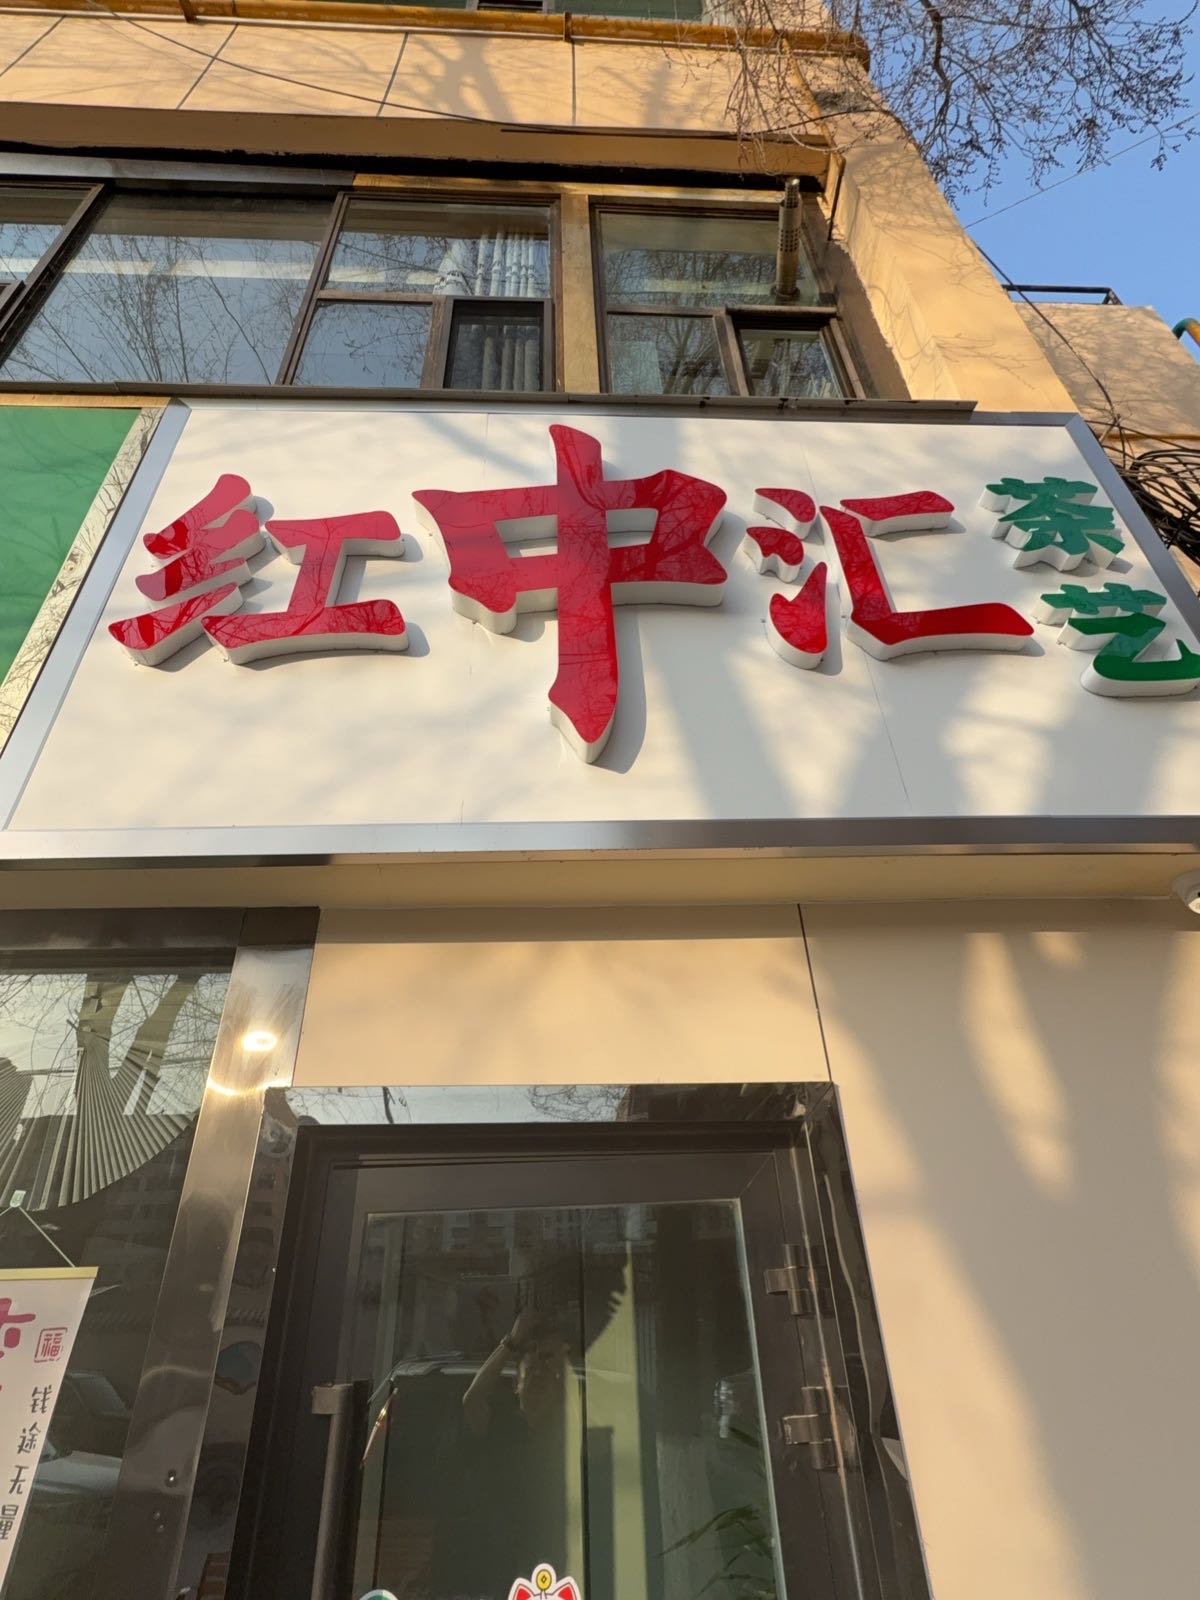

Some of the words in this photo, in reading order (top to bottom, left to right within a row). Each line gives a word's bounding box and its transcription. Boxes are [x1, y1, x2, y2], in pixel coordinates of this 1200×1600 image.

[108, 424, 1034, 760] 红中汇
[980, 476, 1200, 692] 茶艺
[0, 1384, 52, 1541] 钱途无量
